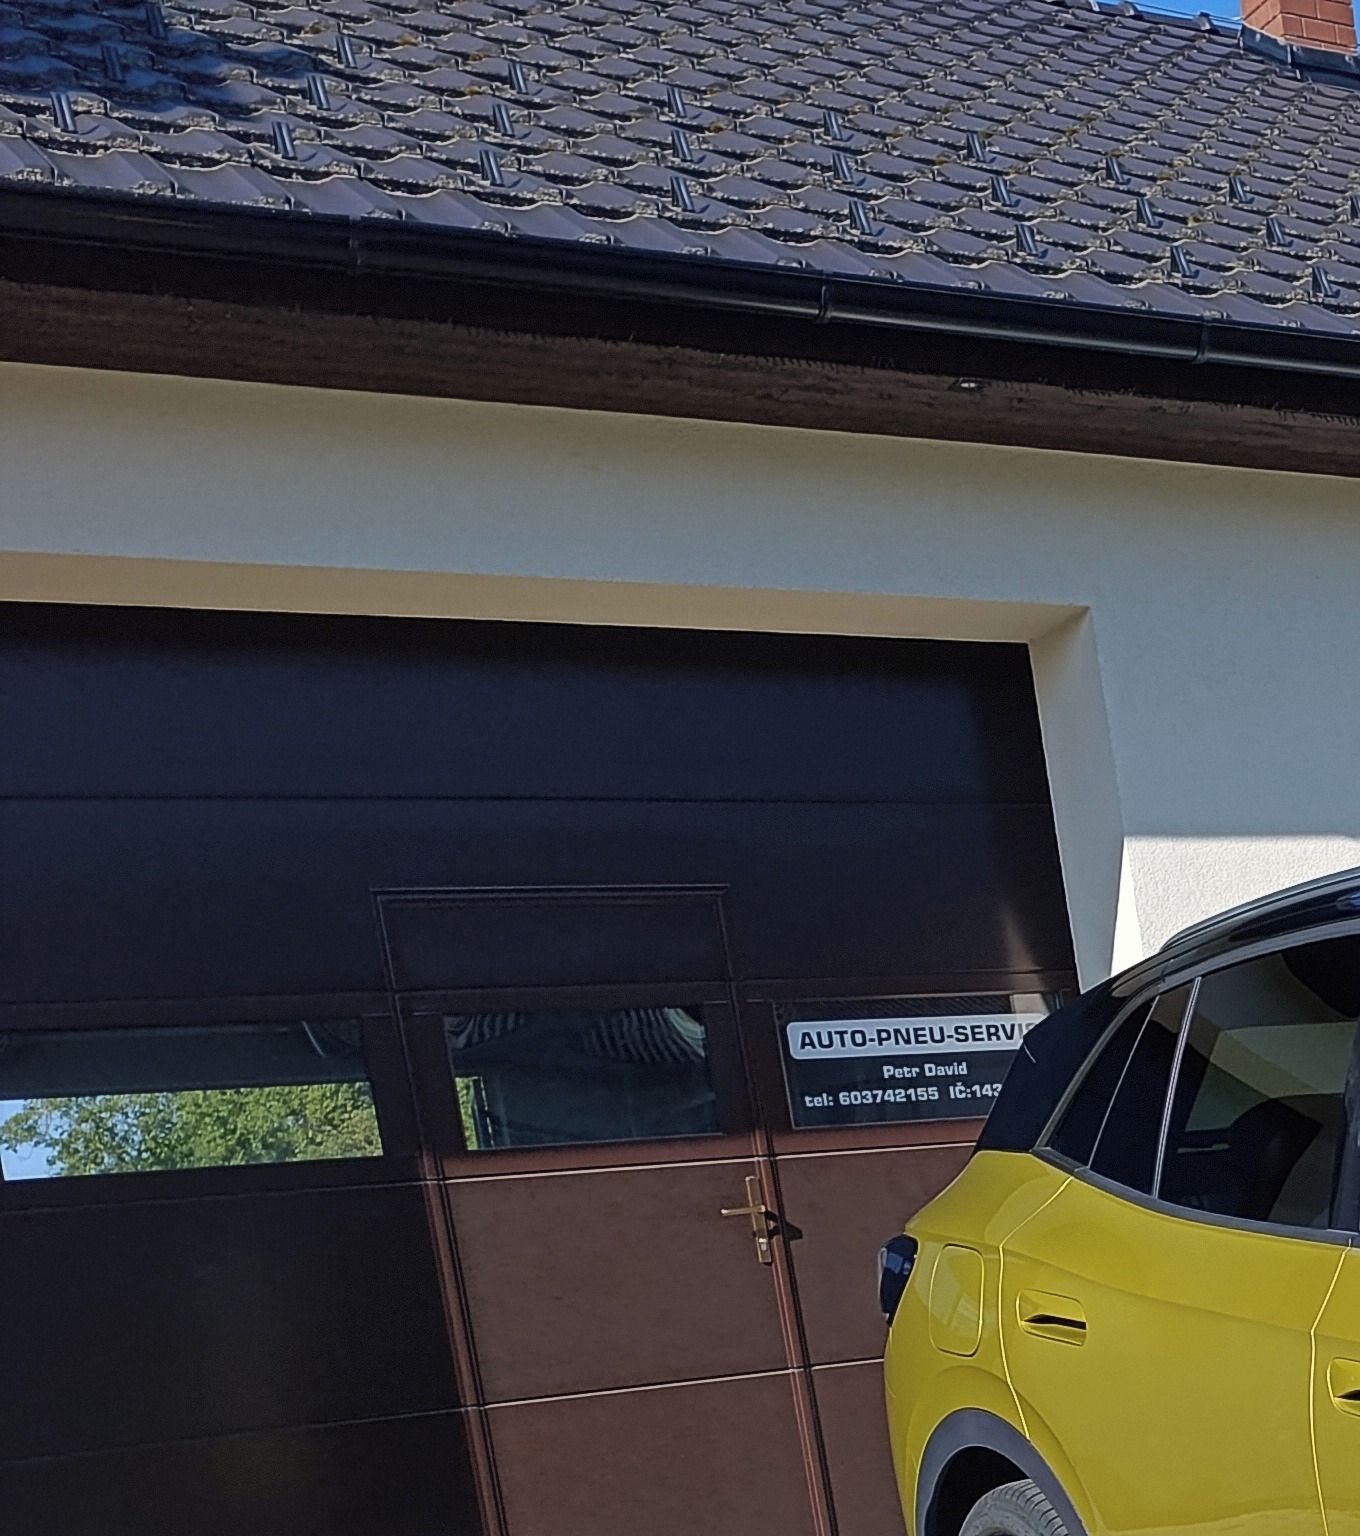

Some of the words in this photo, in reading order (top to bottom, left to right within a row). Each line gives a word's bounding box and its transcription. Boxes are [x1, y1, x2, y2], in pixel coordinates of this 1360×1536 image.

[799, 1022, 1037, 1050] AUTO-PNEU-SERVI
[883, 1065, 920, 1079] Petr
[924, 1062, 967, 1077] David
[804, 1093, 834, 1108] tel:
[838, 1086, 939, 1105] 603742155
